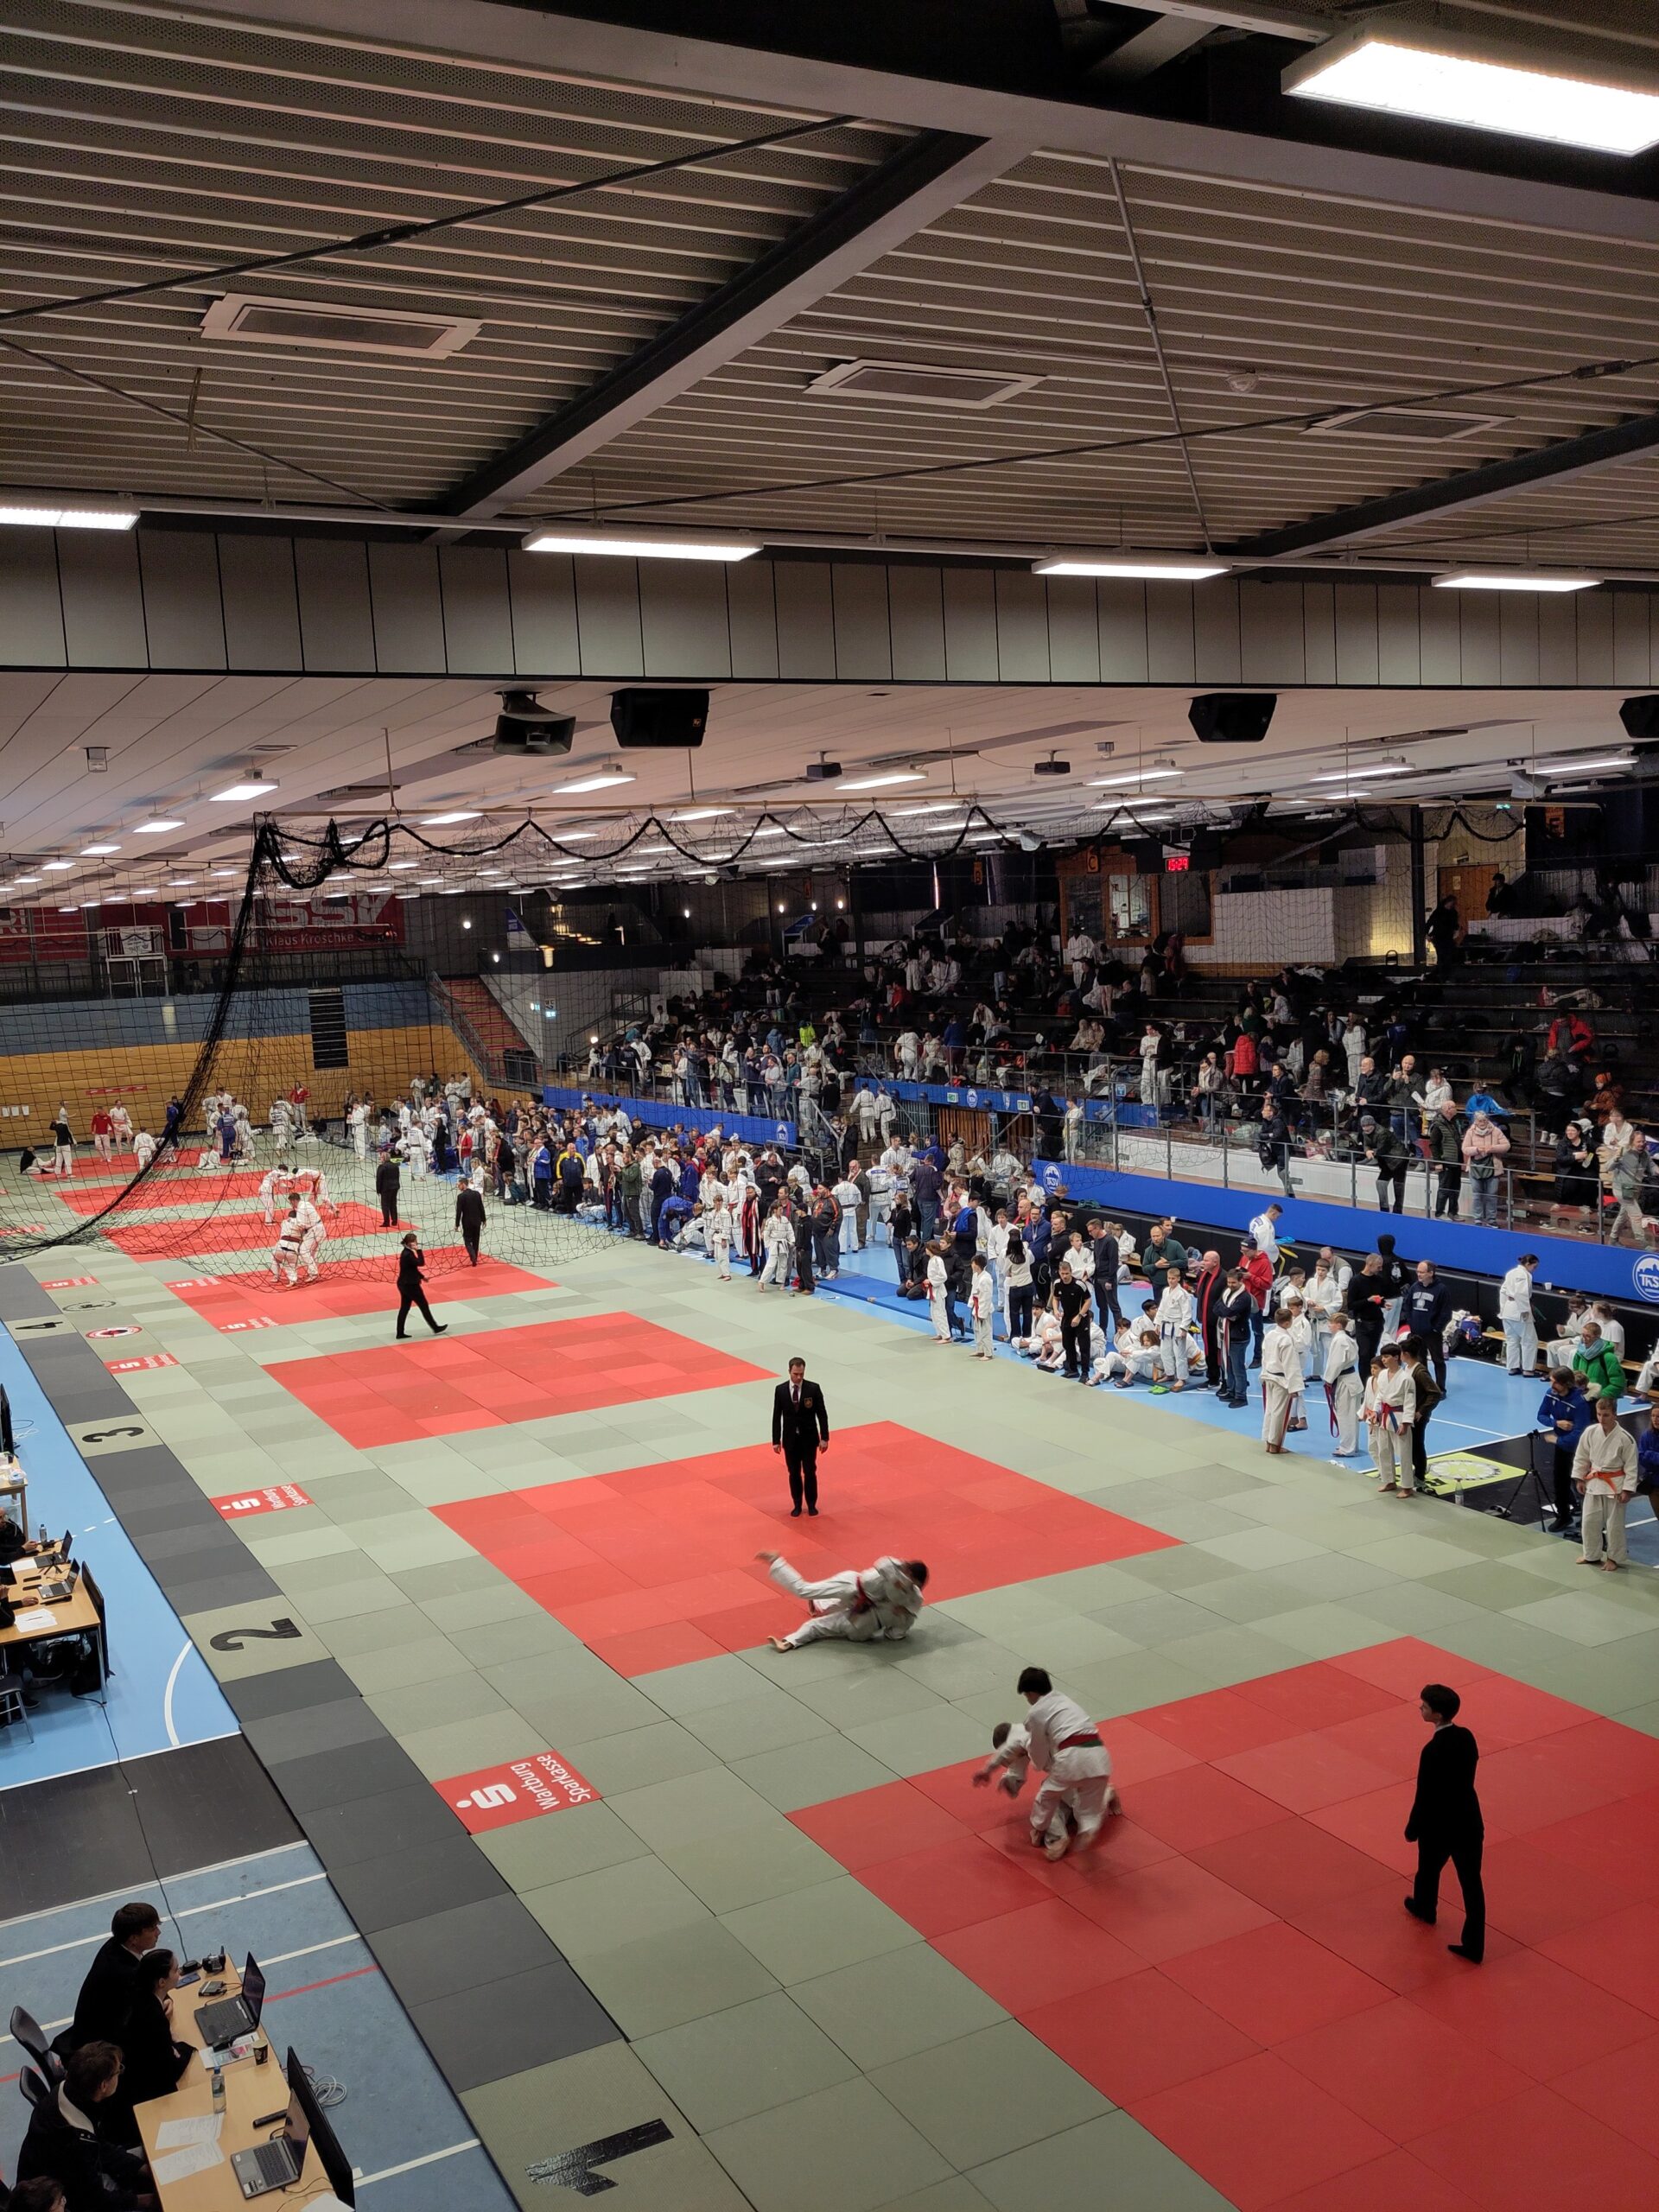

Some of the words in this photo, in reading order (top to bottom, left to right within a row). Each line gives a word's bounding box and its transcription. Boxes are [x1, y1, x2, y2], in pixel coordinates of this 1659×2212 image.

[1088, 855, 1096, 870] C
[1167, 857, 1188, 871] 15:29
[265, 933, 298, 947] Klaus
[300, 931, 354, 945] Kroschke
[15, 1321, 64, 1330] 4
[81, 1427, 145, 1443] 3
[209, 1618, 303, 1651] 2
[510, 1762, 561, 1810] Wartburg
[536, 1754, 591, 1803] Sparkasse
[524, 2118, 675, 2196] 1
